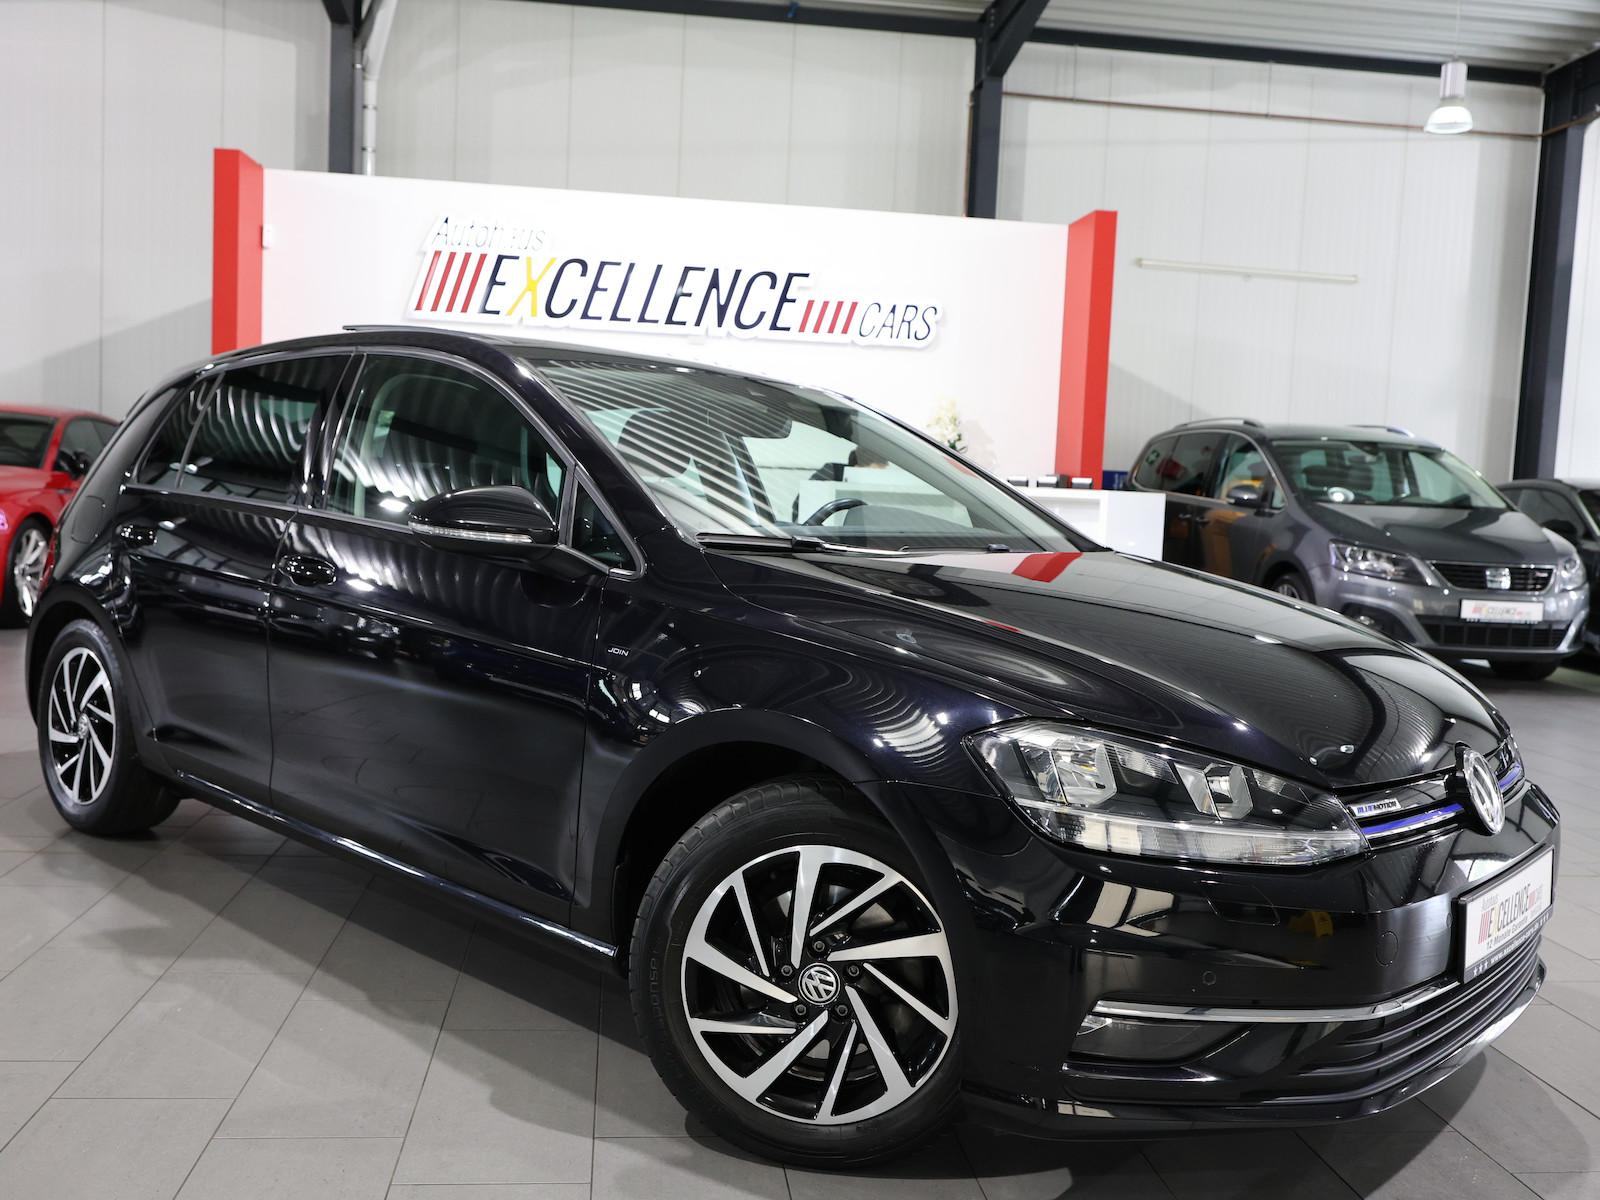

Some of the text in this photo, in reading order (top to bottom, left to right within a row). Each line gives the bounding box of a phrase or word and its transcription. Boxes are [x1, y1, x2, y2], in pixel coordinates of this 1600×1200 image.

[477, 254, 938, 341] EXCELLENCE CARS
[607, 647, 630, 657] JOIN
[1487, 883, 1531, 938] EXCELLENCE
